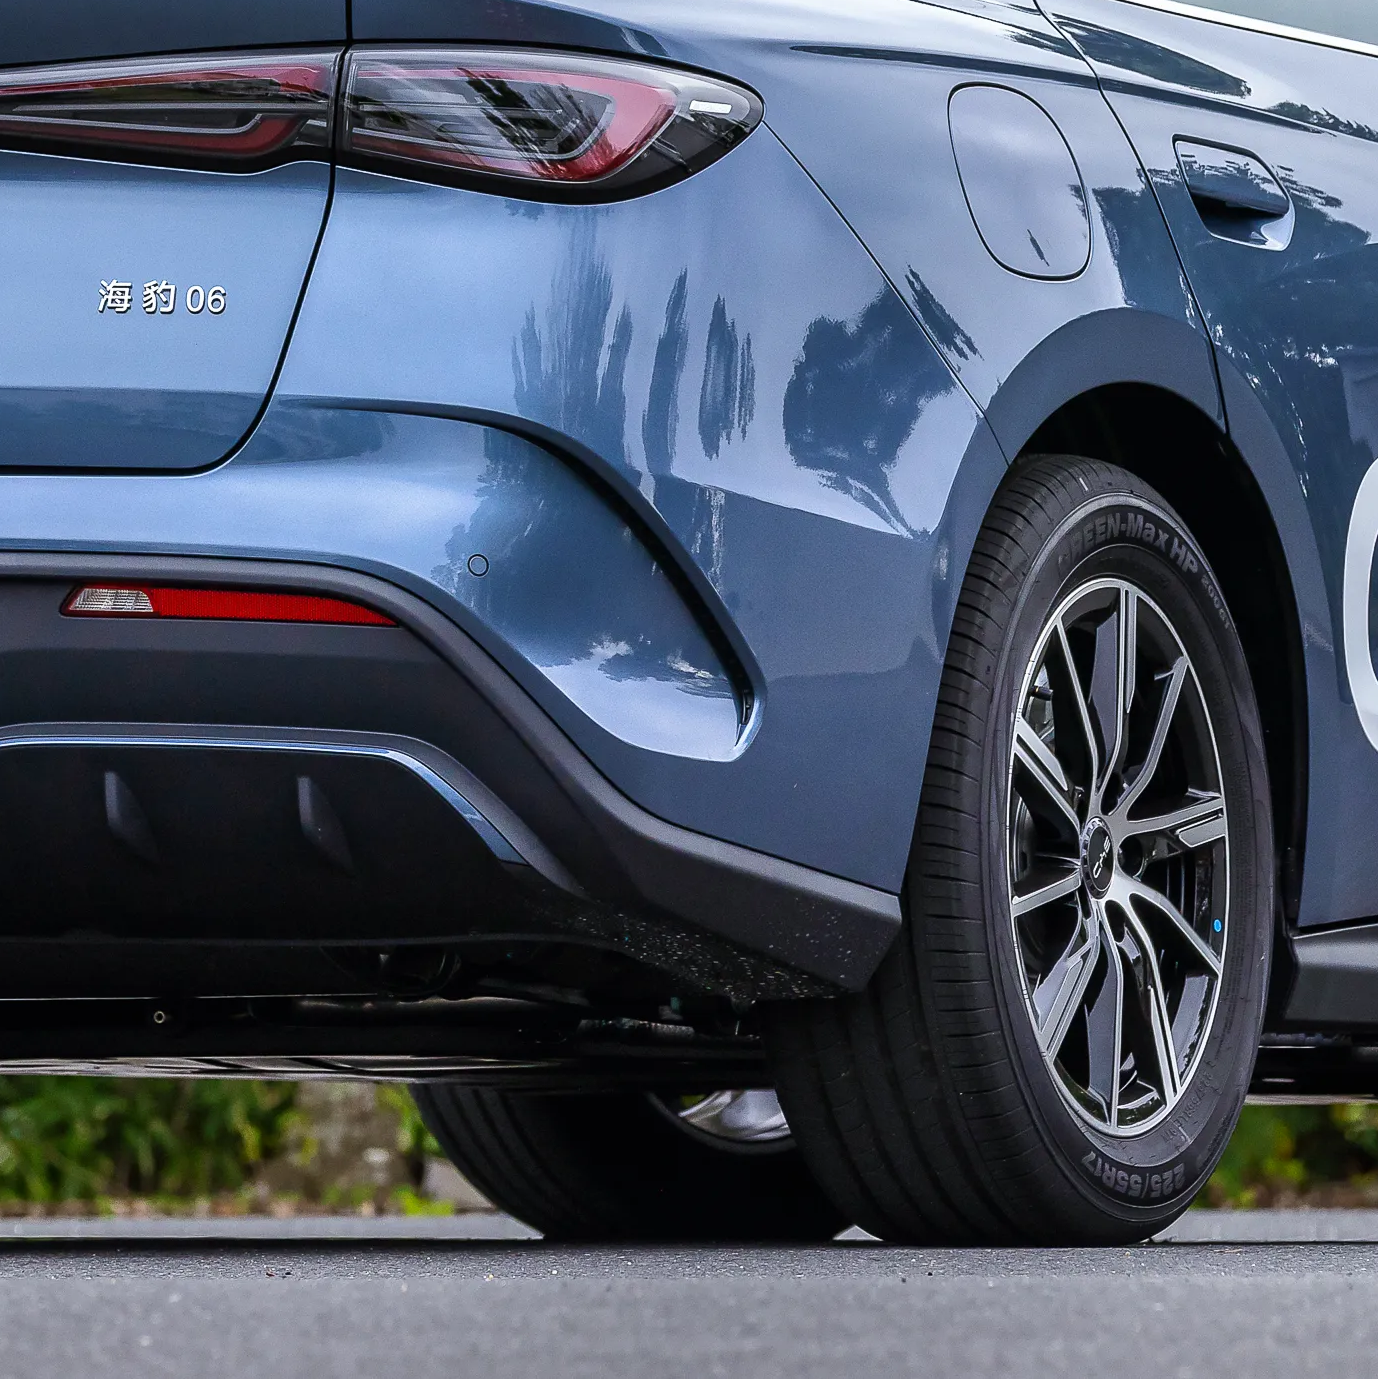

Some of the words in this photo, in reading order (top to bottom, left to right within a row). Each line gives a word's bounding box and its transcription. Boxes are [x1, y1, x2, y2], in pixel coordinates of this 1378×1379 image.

[98, 279, 178, 314] 海豹
[185, 285, 227, 314] 06
[1081, 1151, 1186, 1199] 225/55R17
